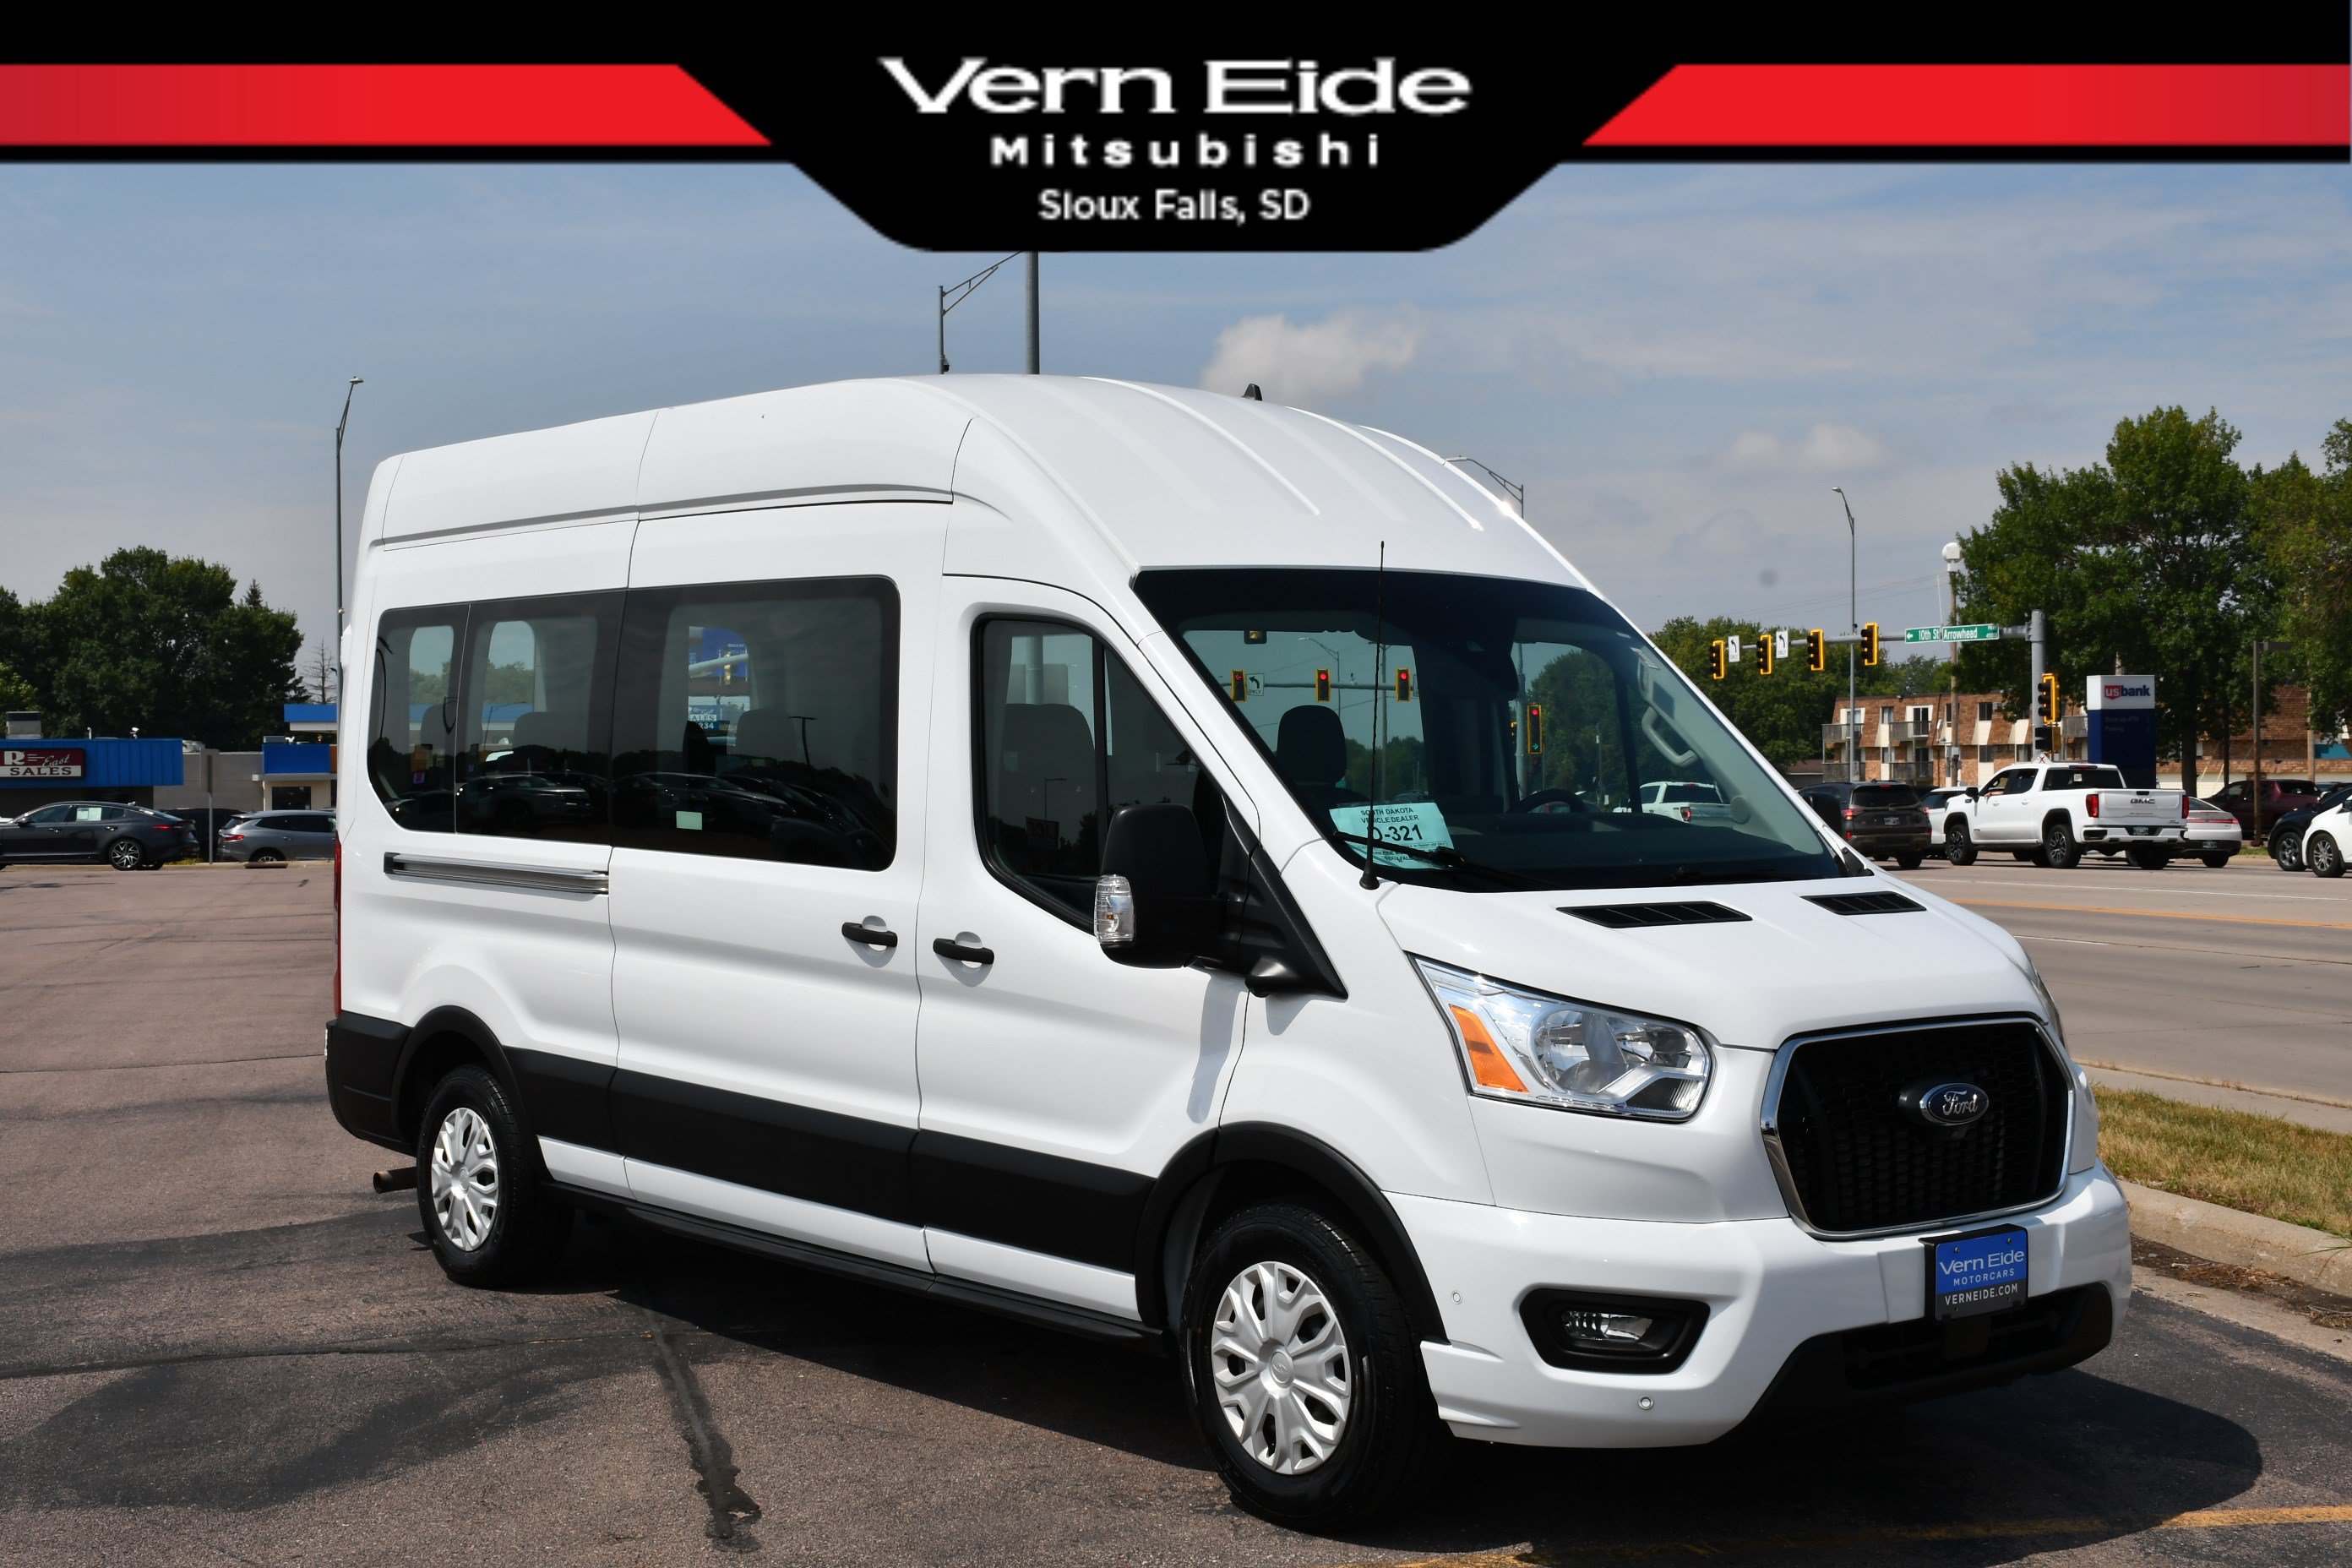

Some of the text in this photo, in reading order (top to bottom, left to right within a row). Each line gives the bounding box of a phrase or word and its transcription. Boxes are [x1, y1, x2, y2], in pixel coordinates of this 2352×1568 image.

[1919, 629, 1939, 640] 10th St
[1943, 628, 1977, 640] Arrowhead
[4, 751, 70, 767] R East
[9, 766, 72, 776] SALES
[1392, 814, 1420, 823] DEALER
[1943, 1091, 1978, 1115] Ford
[1940, 1250, 2025, 1275] Vern Eide
[1953, 1268, 2015, 1286] MOTORCARS
[1945, 1283, 2017, 1305] VERNEIDE.COM
